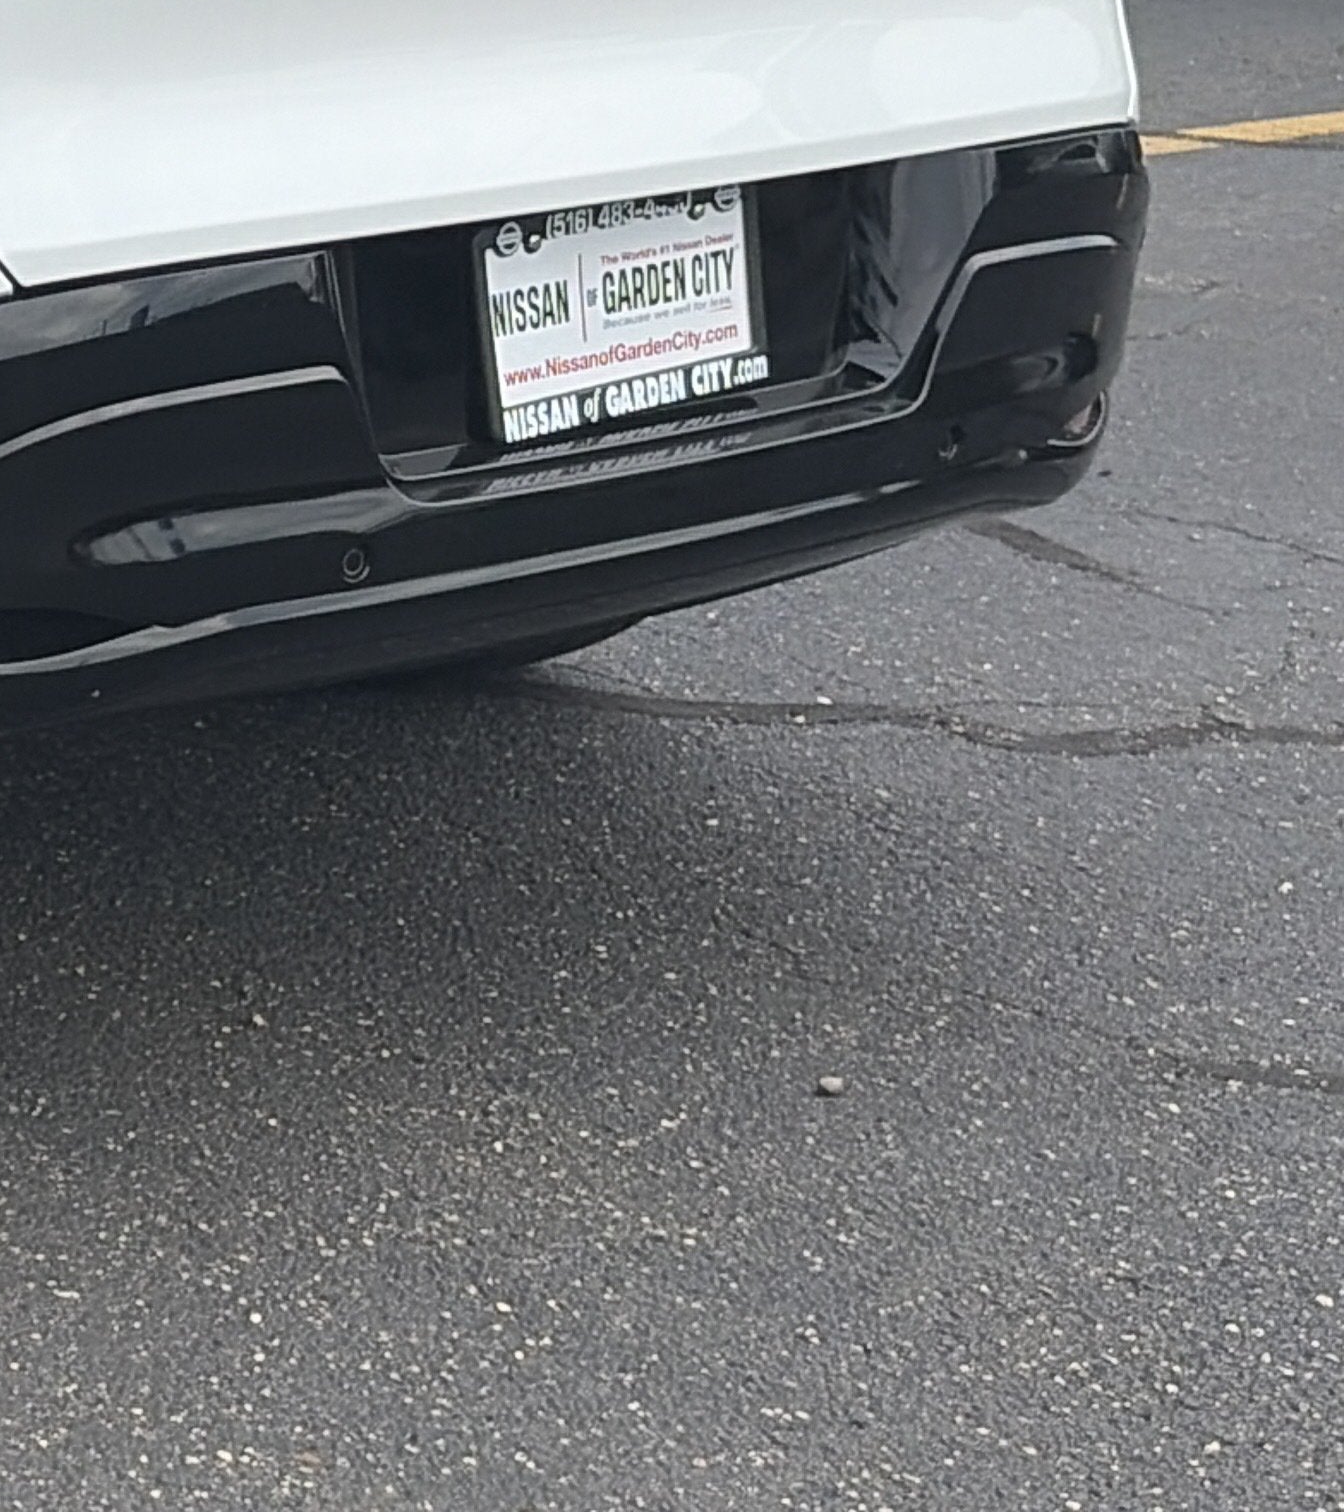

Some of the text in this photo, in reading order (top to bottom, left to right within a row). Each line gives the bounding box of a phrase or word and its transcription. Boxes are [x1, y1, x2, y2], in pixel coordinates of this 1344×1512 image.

[491, 280, 570, 337] NISSAN
[602, 257, 687, 315] GARDEN
[691, 247, 735, 297] CITY
[503, 394, 580, 443] NISSAN
[584, 389, 602, 422] of
[605, 372, 687, 417] GARDEN
[691, 355, 769, 397] CITY.com
[504, 324, 738, 386] www.NissanofGardenCity.com
